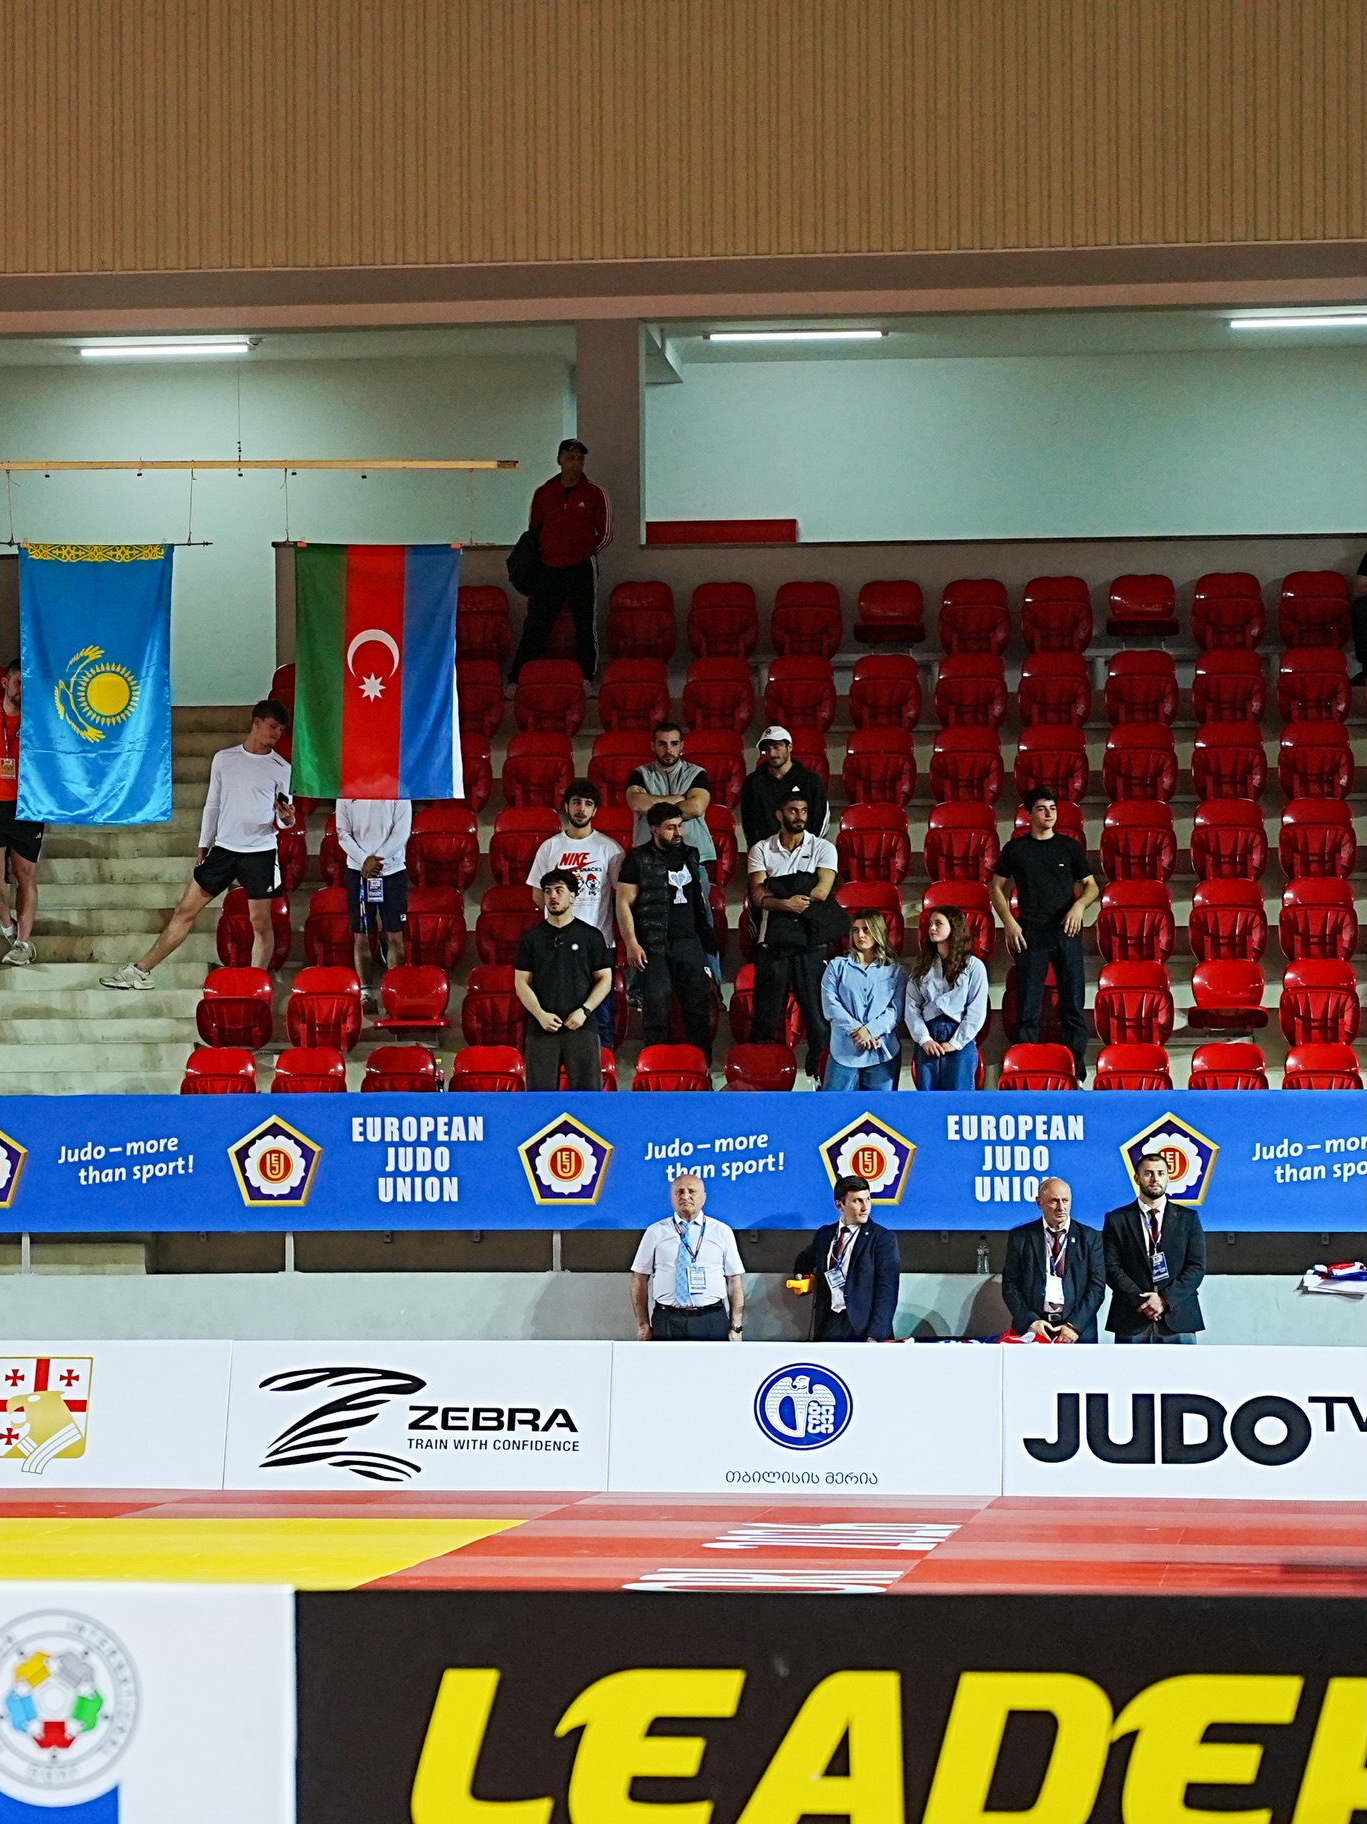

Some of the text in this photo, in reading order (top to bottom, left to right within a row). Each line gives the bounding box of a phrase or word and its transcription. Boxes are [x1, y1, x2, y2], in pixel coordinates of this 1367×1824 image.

[560, 853, 590, 866] NIKE
[352, 1117, 483, 1141] EUROPEAN
[948, 1115, 1083, 1140] EUROPEAN
[58, 1141, 105, 1164] Judo
[126, 1137, 178, 1155] more
[644, 1138, 693, 1160] Judo
[715, 1133, 768, 1152] more
[983, 1146, 1049, 1171] JUDO
[1252, 1138, 1303, 1161] Judo
[78, 1155, 193, 1185] than sport!
[386, 1147, 449, 1172] JUDO
[721, 1152, 784, 1181] sport!
[1274, 1163, 1326, 1183] than
[379, 1177, 458, 1202] UNION
[975, 1176, 1058, 1202] UNIO
[408, 1405, 578, 1432] ZEBRA
[407, 1438, 579, 1451] TRAIN WITH CONFIDENCE
[726, 1470, 878, 1485] თბილისის მერია
